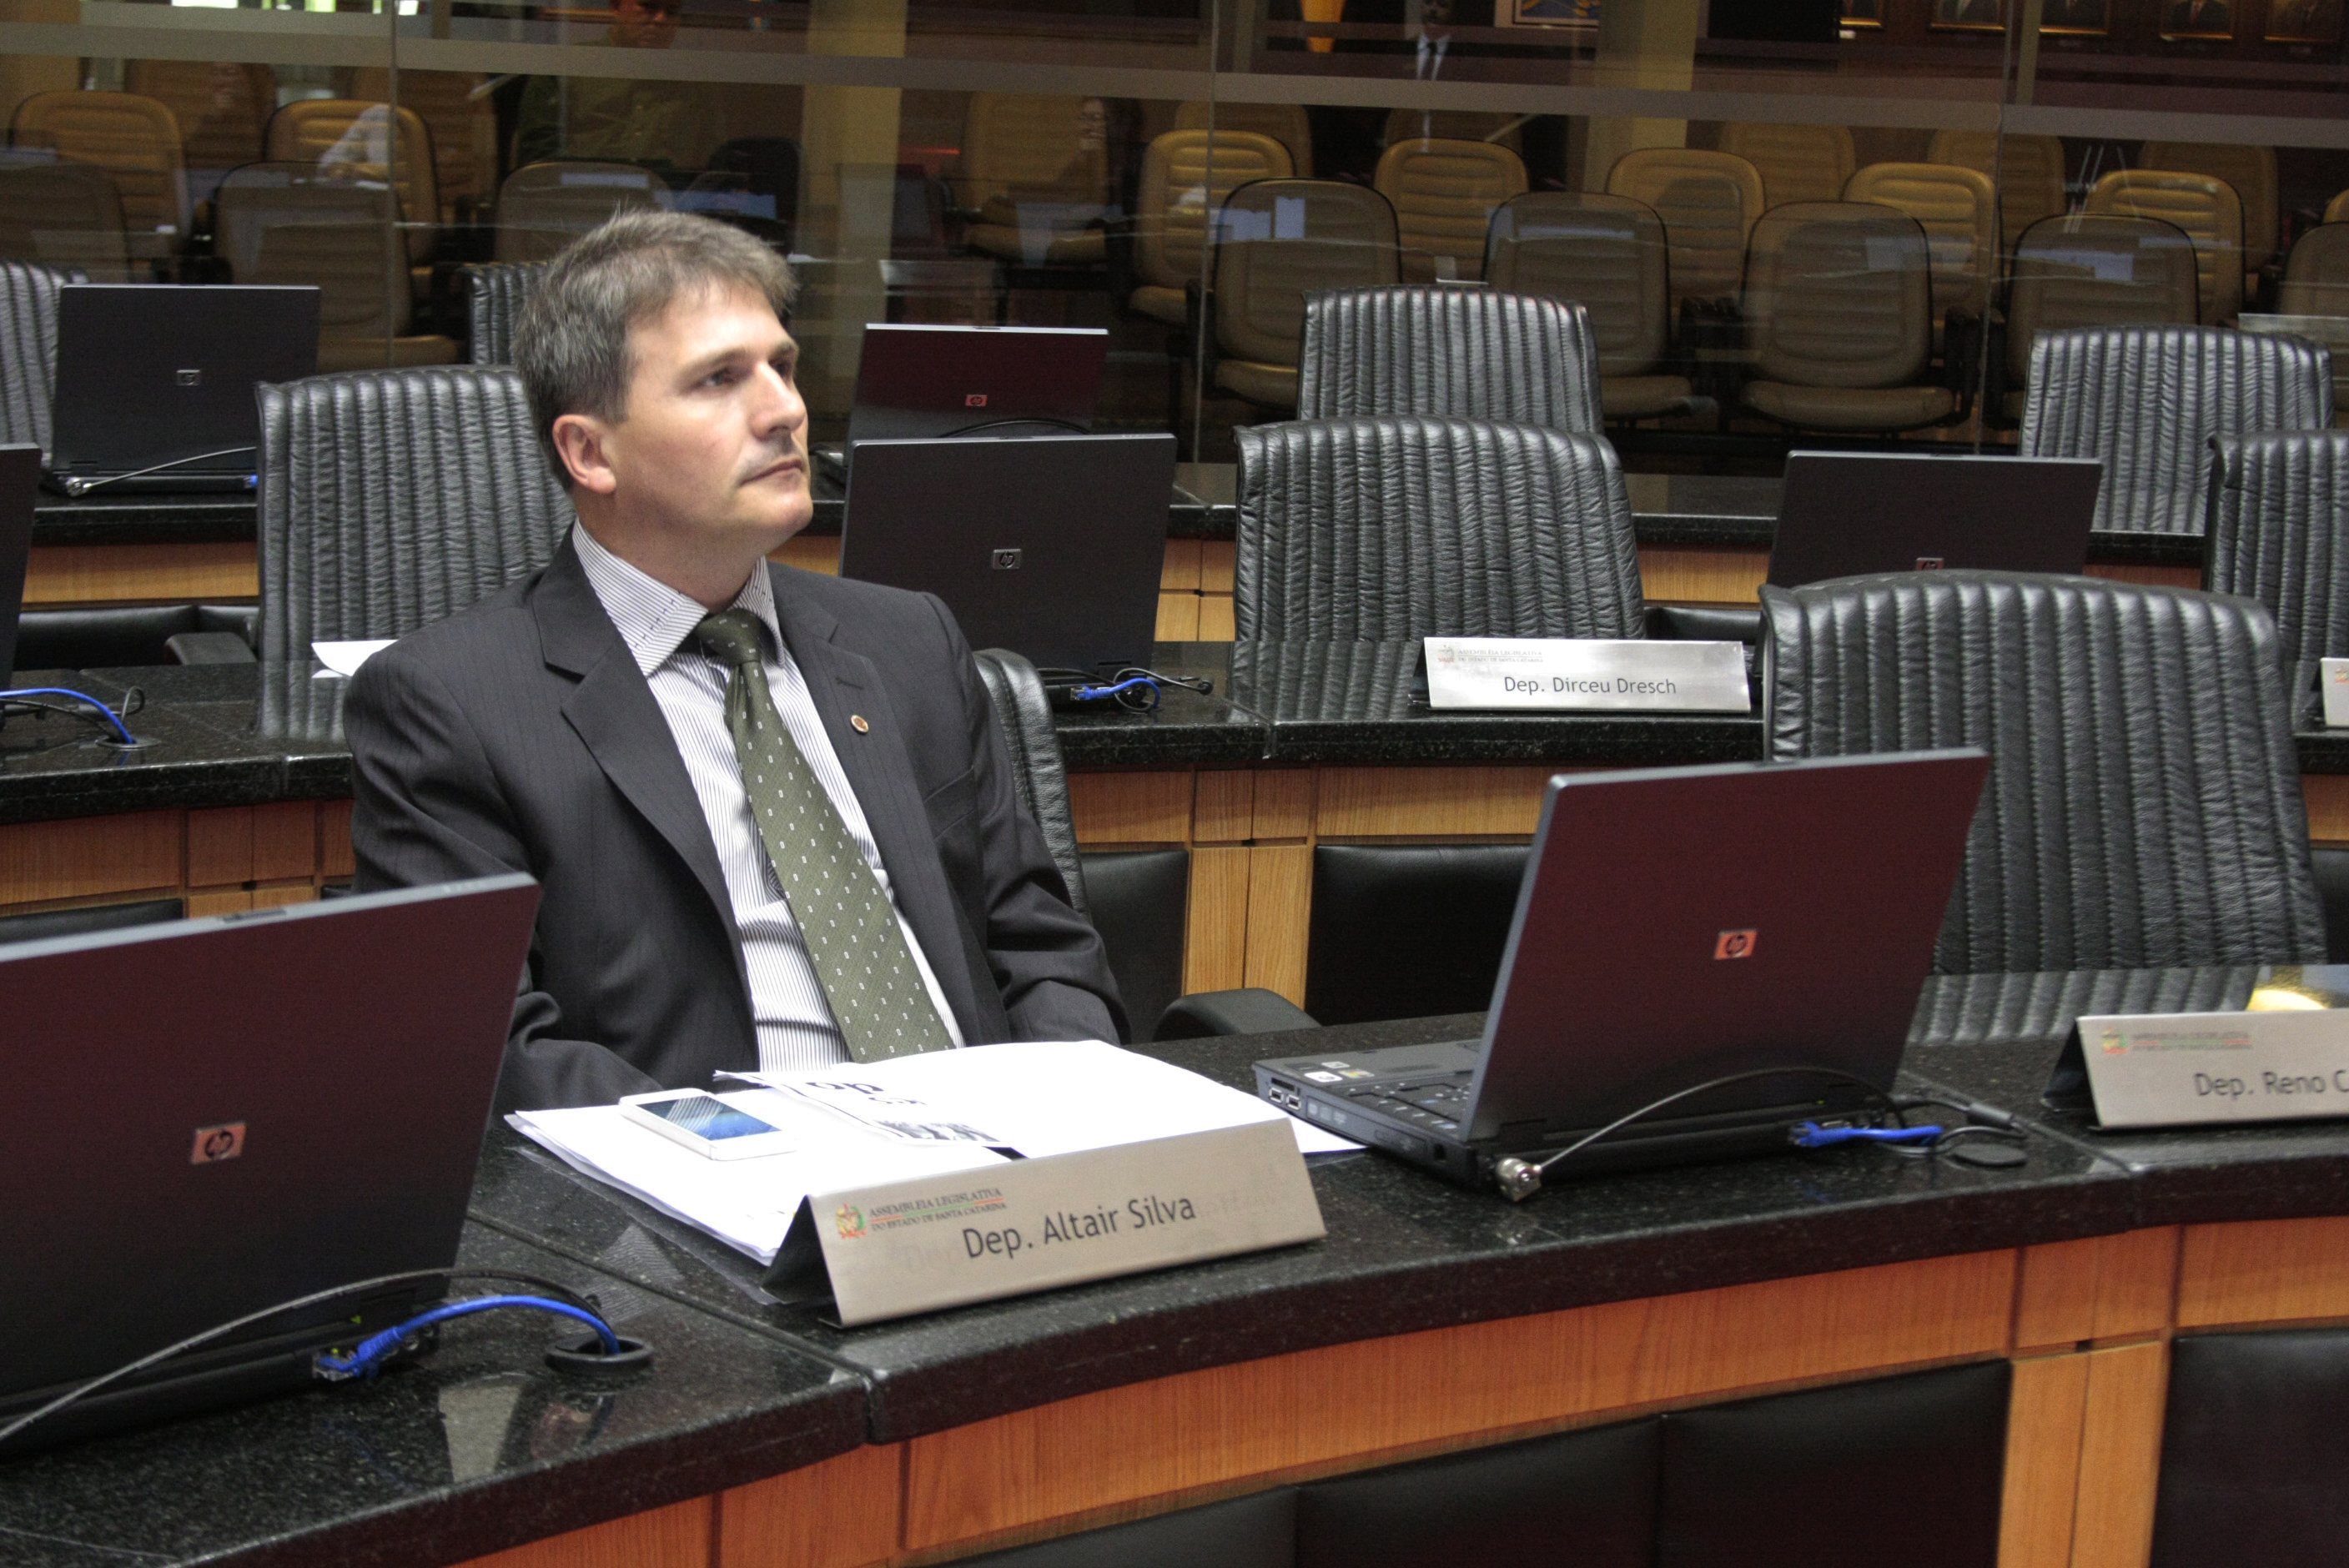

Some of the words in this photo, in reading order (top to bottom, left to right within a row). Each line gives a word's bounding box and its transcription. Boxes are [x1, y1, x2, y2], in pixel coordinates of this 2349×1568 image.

[1504, 676, 1545, 696] Dep.
[1552, 676, 1611, 693] Dirceu
[1617, 677, 1677, 694] Dresch
[2193, 1073, 2254, 1100] Dep.
[2261, 1071, 2326, 1094] Reno
[963, 1228, 1034, 1260] Dep.
[1044, 1205, 1119, 1244] Altair
[1128, 1195, 1196, 1229] Silva
